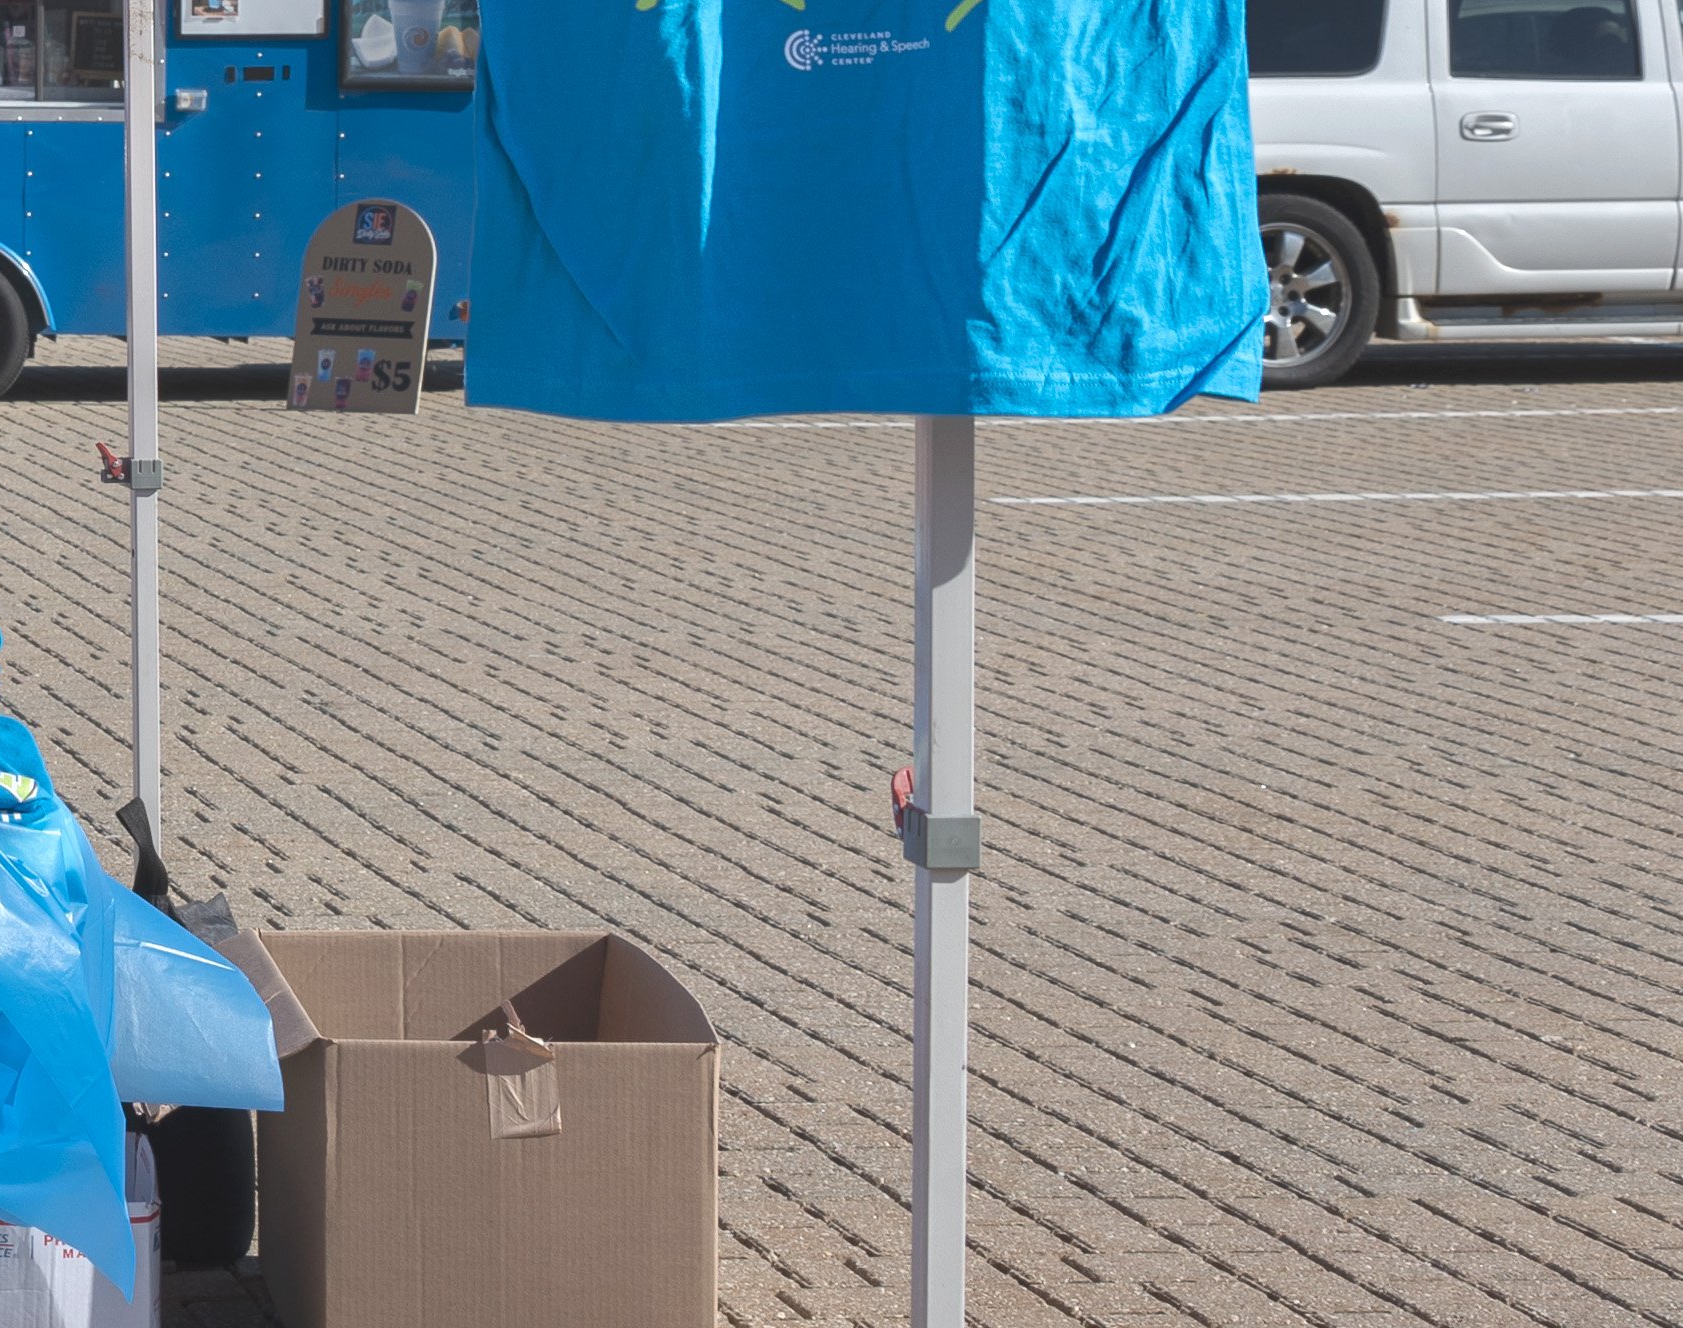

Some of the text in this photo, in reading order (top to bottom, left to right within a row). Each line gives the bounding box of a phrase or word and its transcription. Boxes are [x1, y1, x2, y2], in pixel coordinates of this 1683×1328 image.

[830, 30, 892, 41] CLEVELAND
[830, 37, 931, 56] Hearing & Speech
[831, 57, 872, 66] CENTER
[323, 256, 413, 276] DIRTY SODA
[321, 322, 406, 334] ASK ABOUT FLAVORS
[371, 358, 412, 393] $5
